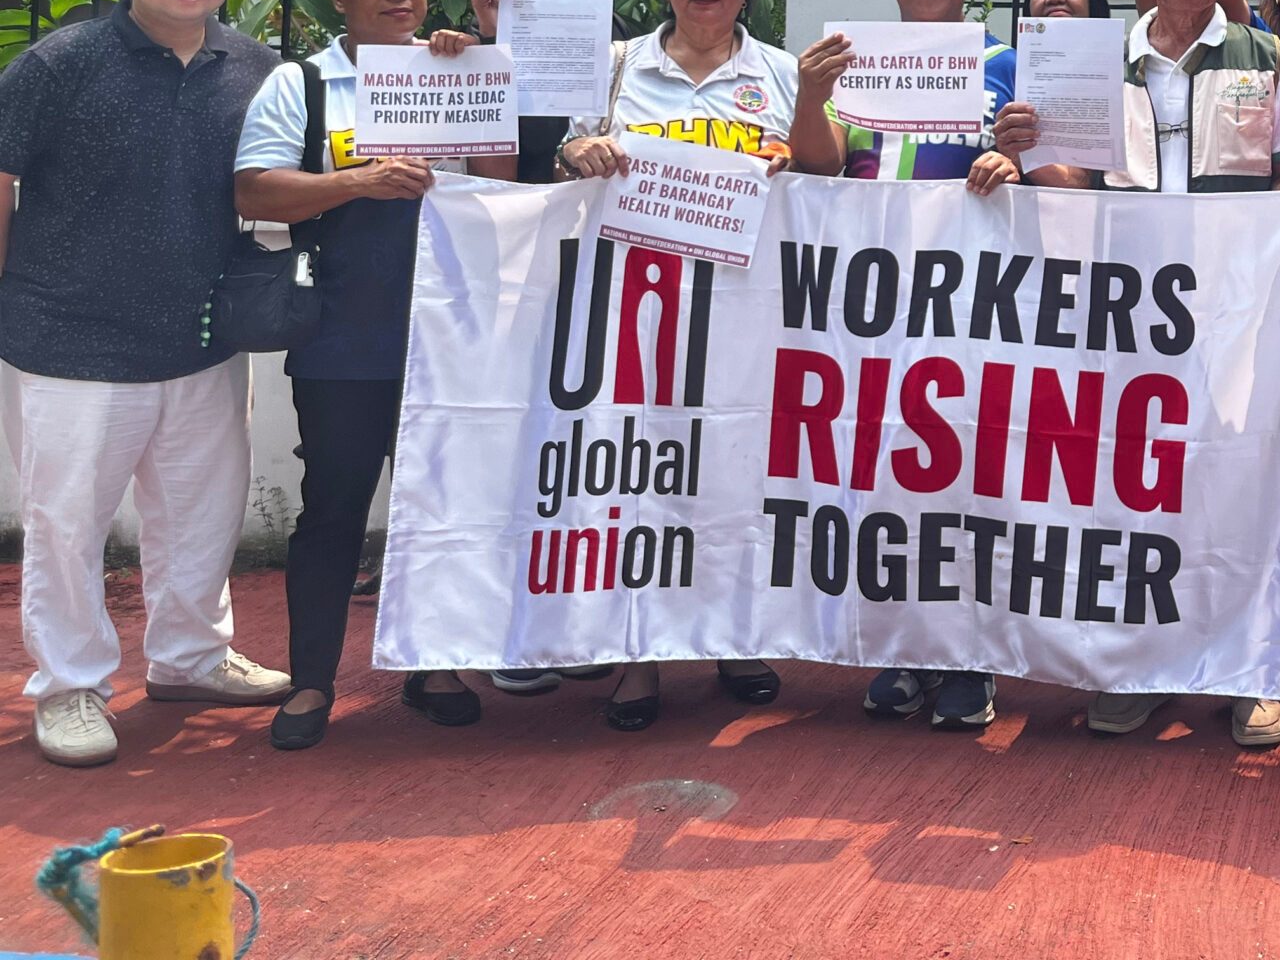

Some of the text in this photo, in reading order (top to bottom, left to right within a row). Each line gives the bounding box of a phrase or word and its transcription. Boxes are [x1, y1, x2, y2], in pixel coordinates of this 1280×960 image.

[364, 72, 511, 87] MAGNA CARTA OF BHW
[847, 56, 978, 70] GNA CARTA OF BHW
[371, 90, 505, 105] REINSTATE AS LEDAC
[840, 75, 968, 90] CERTIFY AS URGENT
[374, 108, 501, 123] PRIORITY MEASURE
[873, 122, 918, 130] CONFEDERATION
[360, 146, 390, 154] NATIONAL
[494, 144, 512, 152] UNION
[638, 180, 735, 211] OF BARANGAY
[661, 164, 710, 190] MAGNA
[714, 175, 759, 197] CARTA
[618, 195, 745, 234] HEALTH WORKERS!
[602, 227, 628, 240] NATIONAL
[629, 234, 642, 243] BHW
[643, 236, 688, 252] CONFEDERATION
[705, 250, 727, 261] GLOBAL
[727, 254, 746, 264] UNION
[779, 239, 1198, 357] WORKERS
[548, 238, 714, 411] UNI
[766, 347, 1189, 513] RISING
[537, 418, 700, 517] global
[527, 506, 695, 595] union
[762, 498, 1181, 625] TOGETHER
